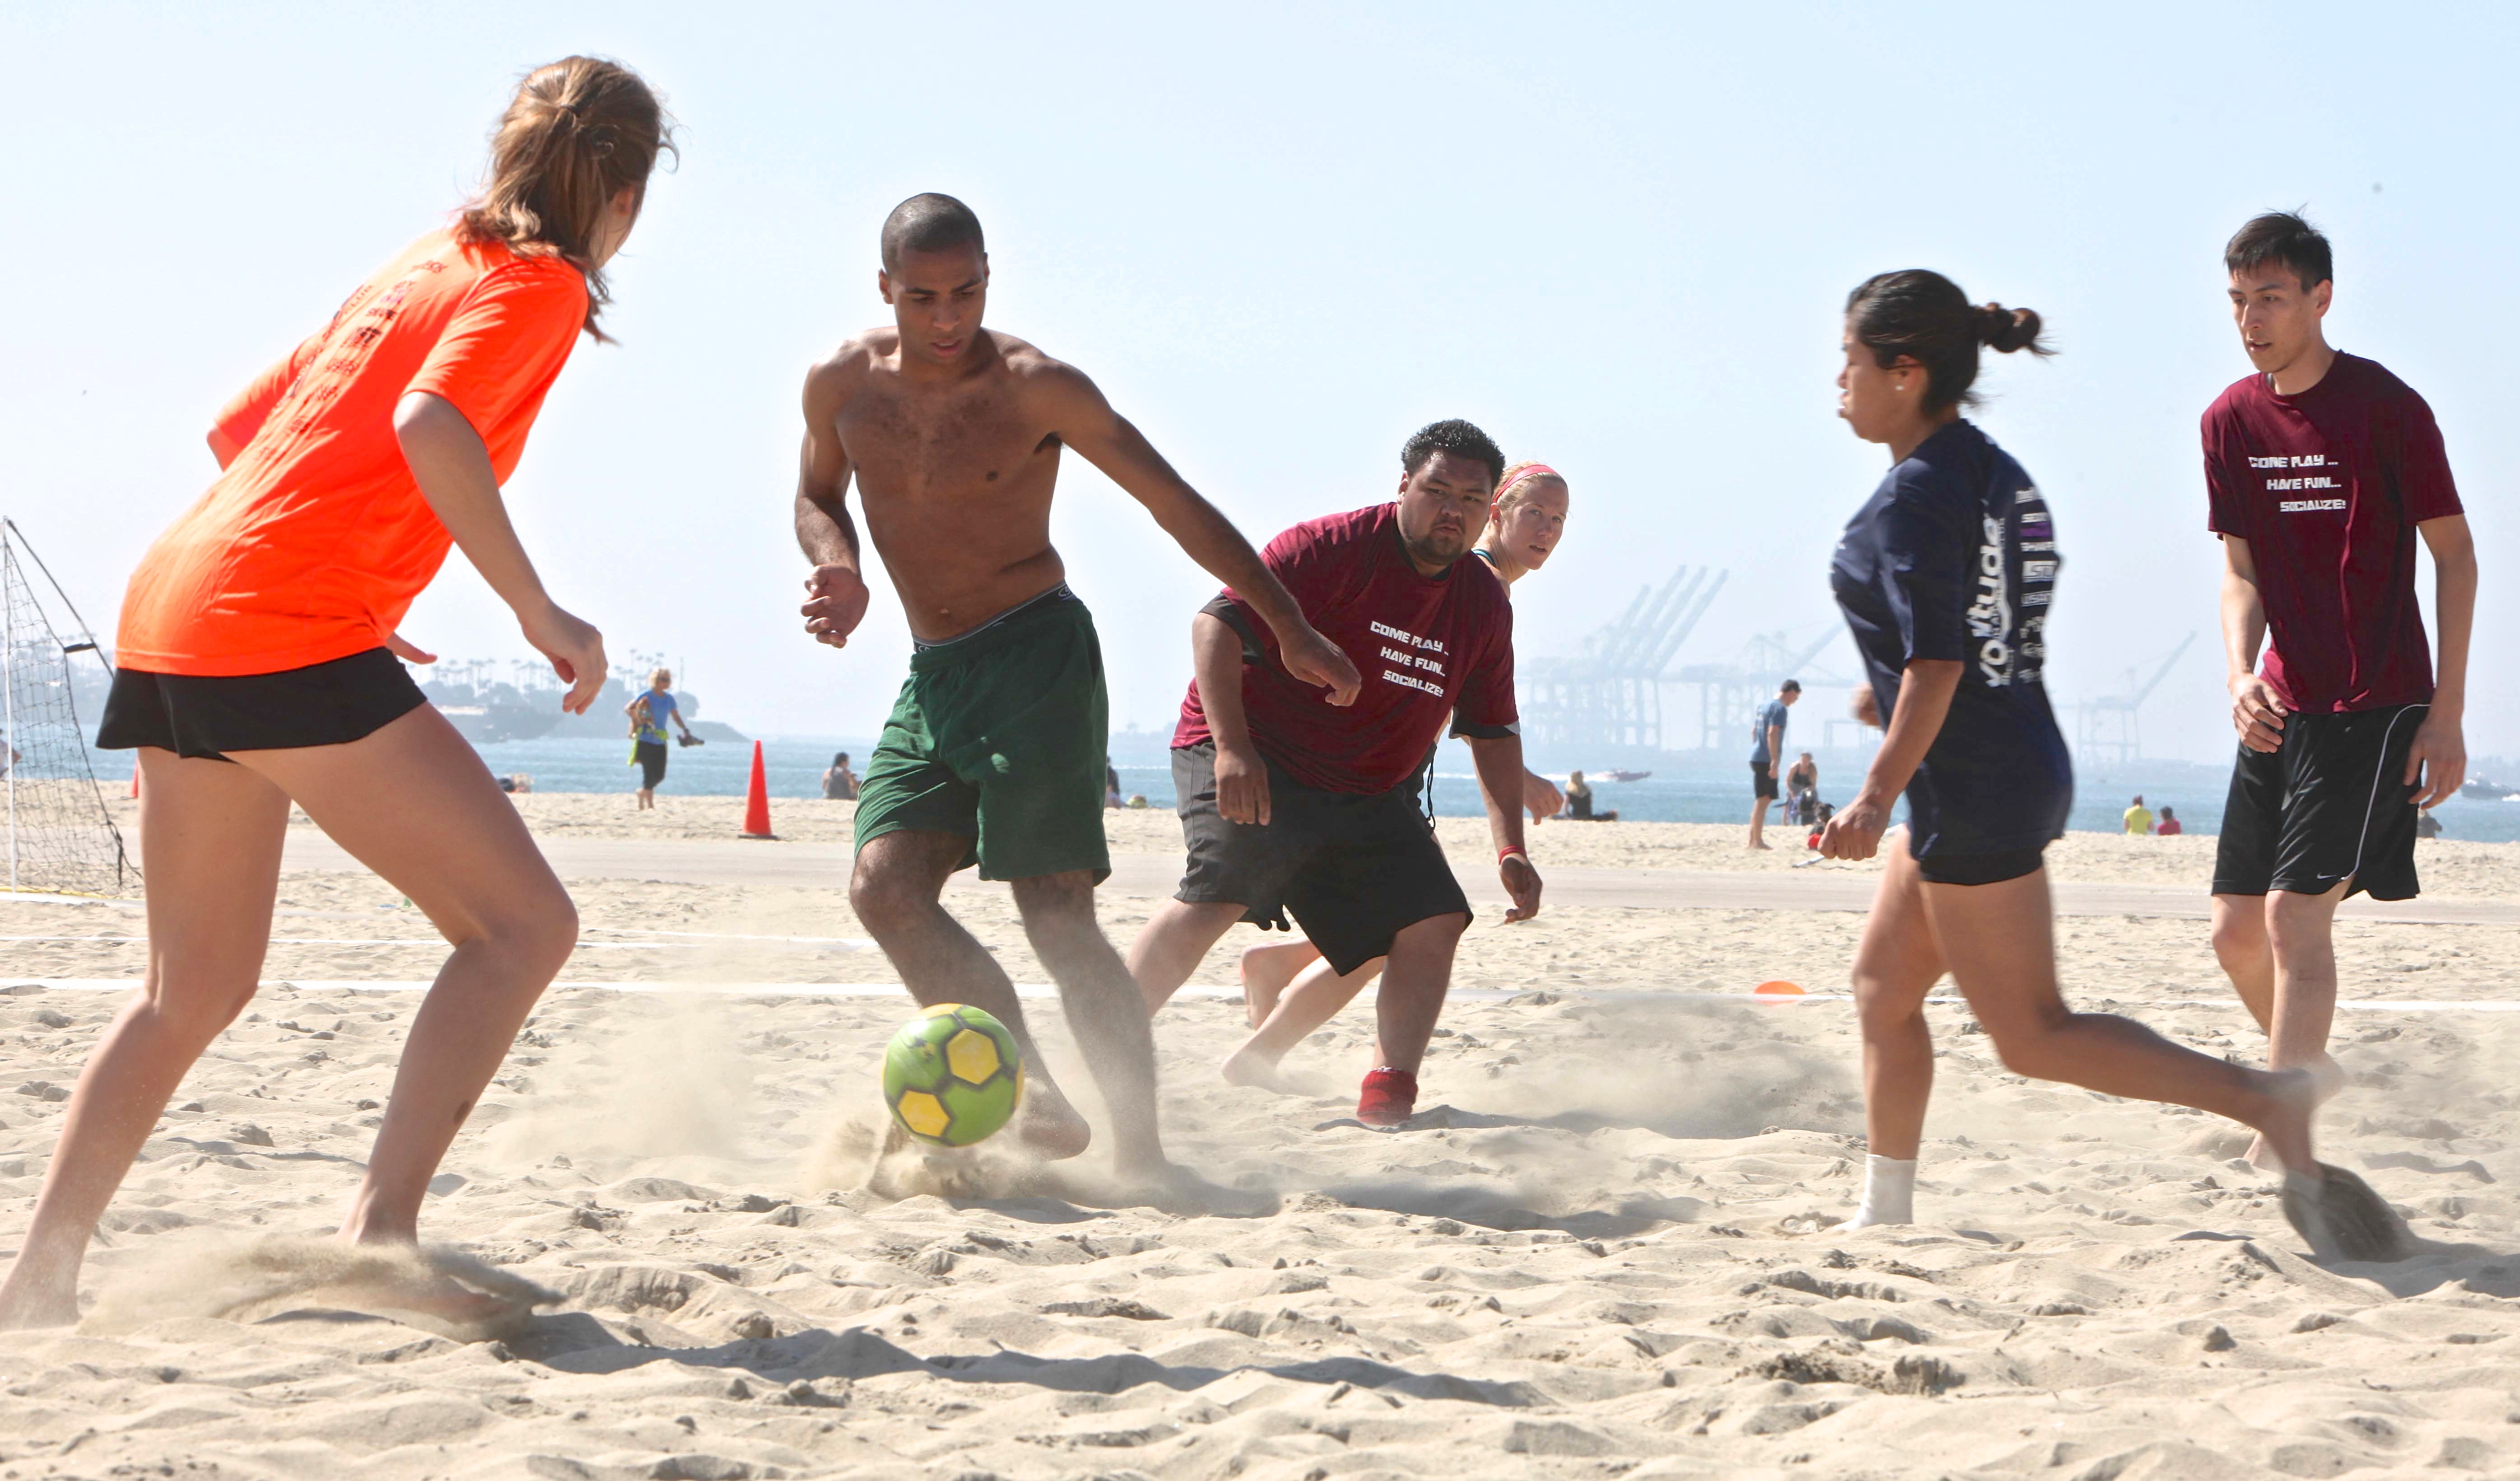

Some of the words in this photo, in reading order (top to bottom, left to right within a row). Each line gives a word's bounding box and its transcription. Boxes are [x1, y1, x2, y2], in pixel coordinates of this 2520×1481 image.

[2248, 457, 2288, 468] COME
[2266, 478, 2302, 491] HAVE
[2279, 499, 2346, 513] SOCIALIZE!
[1370, 621, 1411, 644] COME
[1411, 635, 1443, 652] PLAY
[1380, 646, 1412, 667] HAVE
[1382, 669, 1444, 697] SOCIALIZE!
